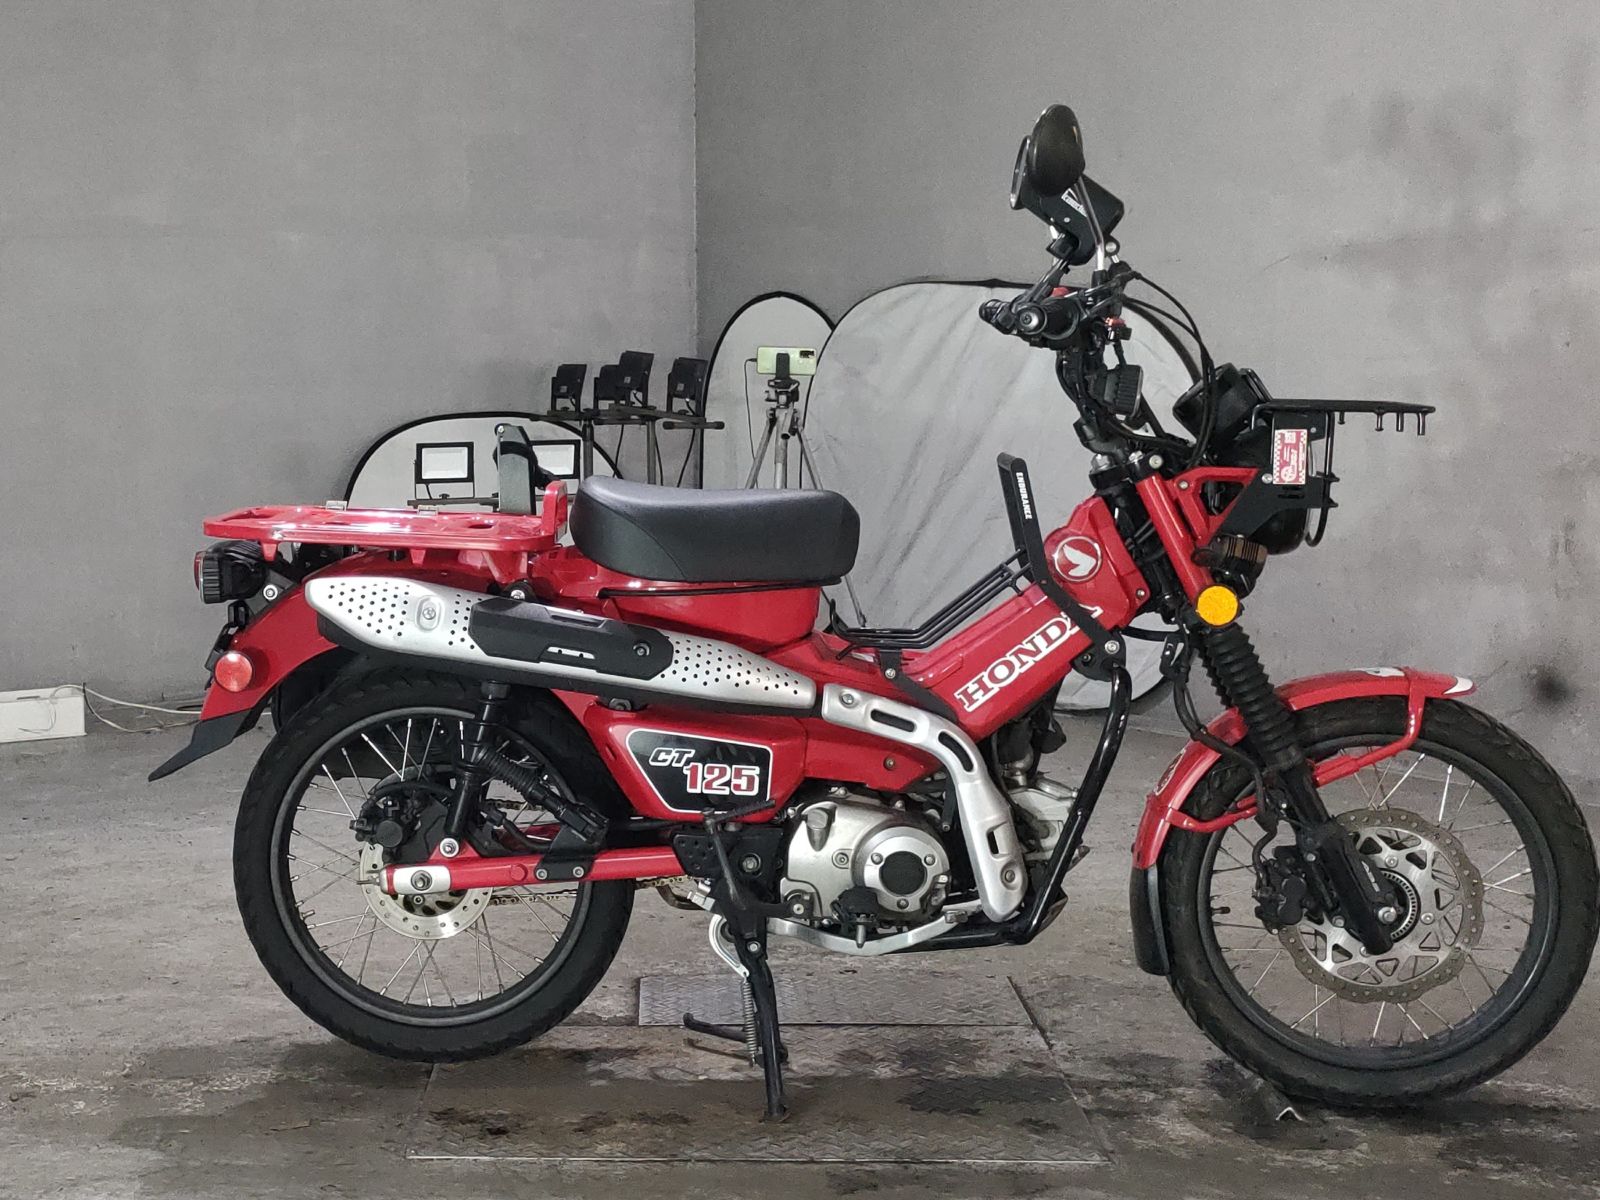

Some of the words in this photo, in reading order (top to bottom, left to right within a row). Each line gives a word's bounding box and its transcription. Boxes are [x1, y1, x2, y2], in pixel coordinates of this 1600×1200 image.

[1016, 472, 1032, 519] ENDURANCE
[649, 747, 695, 767] CT
[682, 762, 760, 796] 125
